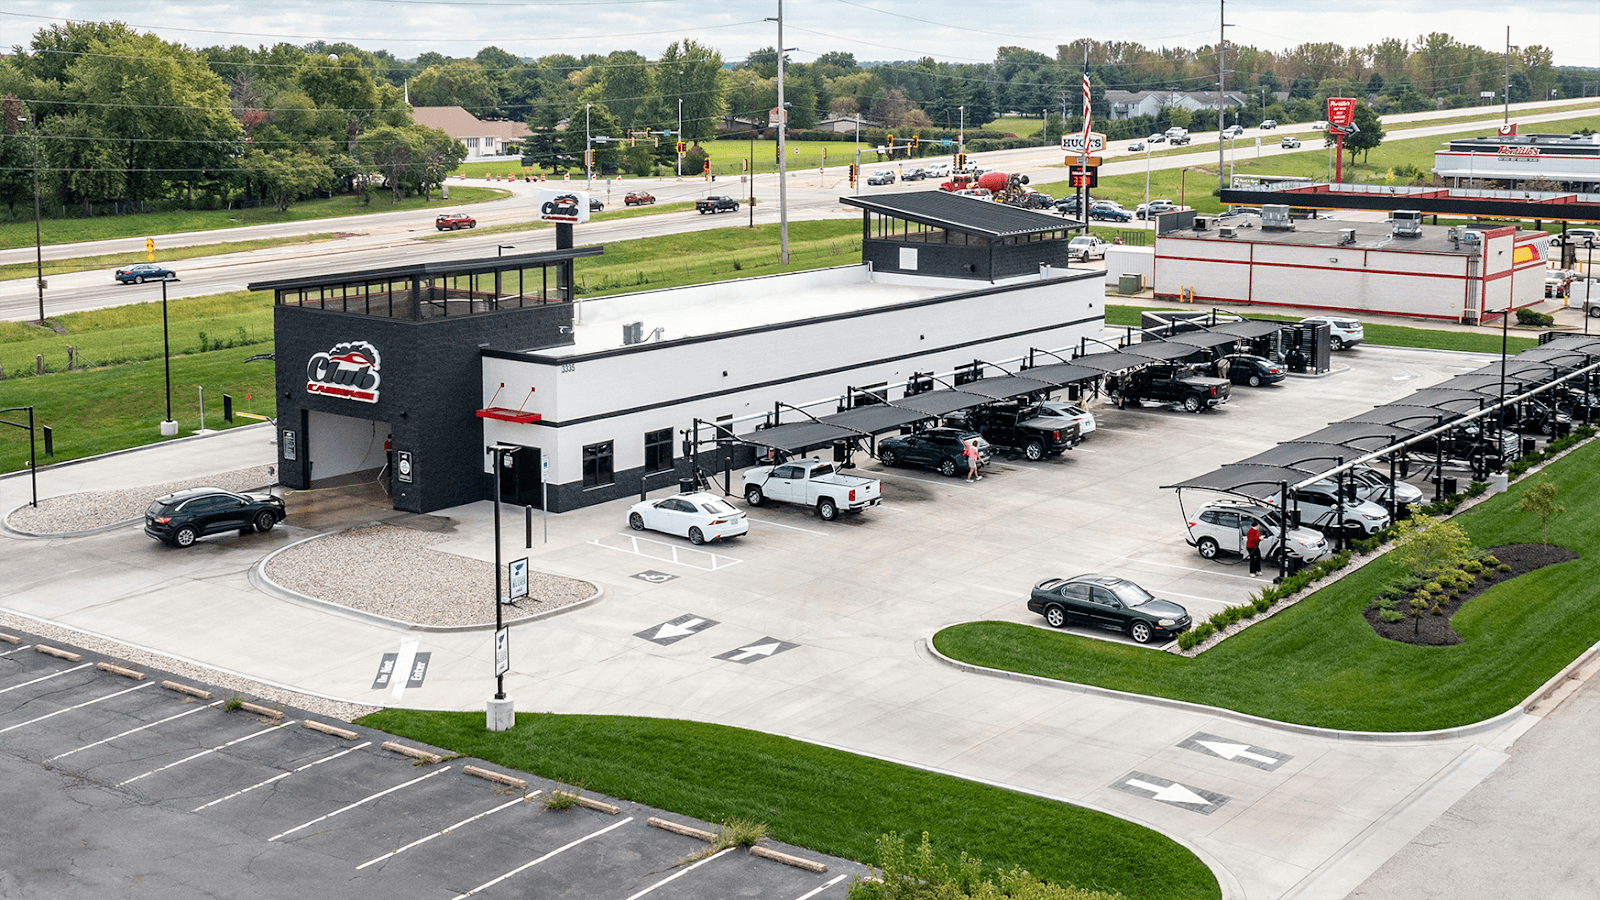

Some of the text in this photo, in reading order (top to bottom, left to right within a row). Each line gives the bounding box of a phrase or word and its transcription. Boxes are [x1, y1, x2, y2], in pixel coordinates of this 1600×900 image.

[1063, 139, 1101, 147] HUC'S
[1498, 145, 1541, 156] Portillo's
[541, 201, 579, 216] Club
[308, 356, 376, 390] Club
[410, 661, 426, 681] Enter
